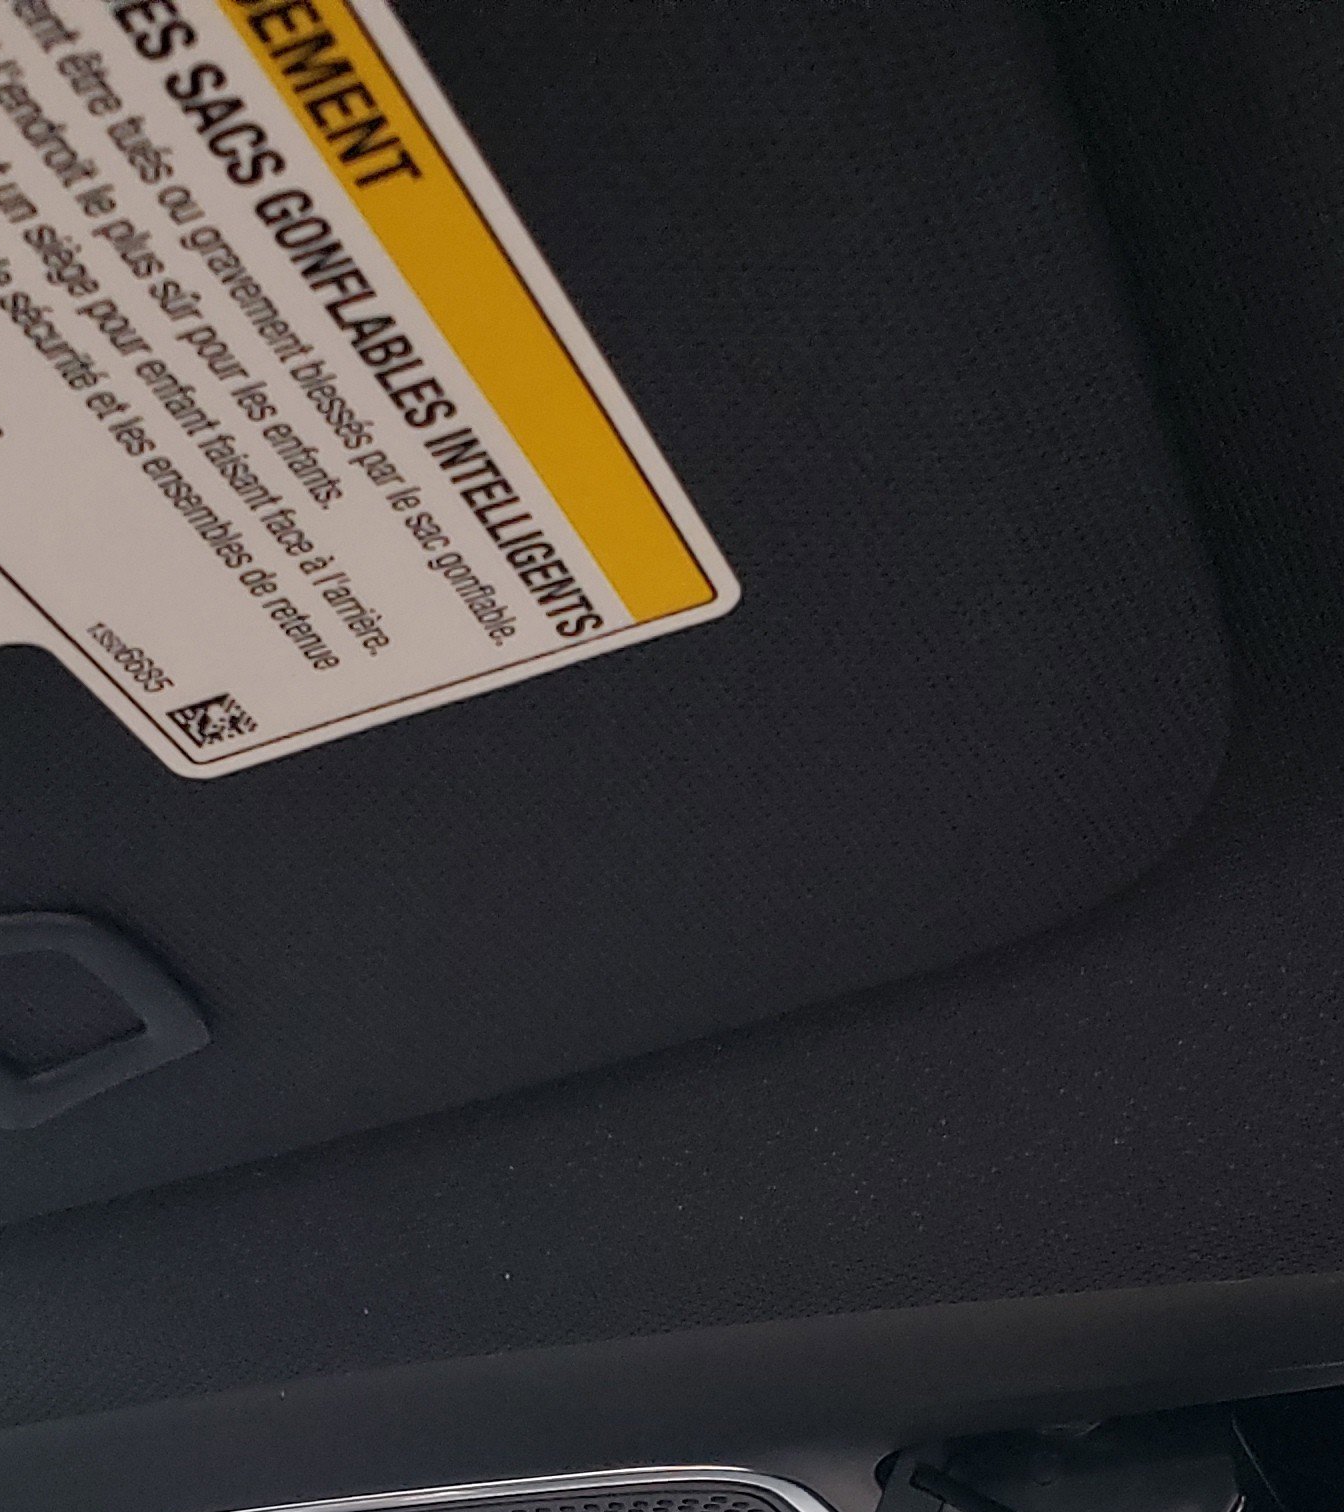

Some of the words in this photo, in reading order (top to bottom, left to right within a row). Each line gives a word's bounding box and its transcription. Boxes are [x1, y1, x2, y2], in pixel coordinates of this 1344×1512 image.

[58, 51, 122, 116] être
[238, 0, 423, 190] EMENT
[107, 115, 174, 184] tués
[75, 184, 116, 217] le
[158, 185, 205, 225] ou
[23, 224, 99, 297] siège
[92, 218, 165, 280] plus
[149, 279, 203, 321] sûr
[180, 226, 314, 363] gravement
[76, 299, 153, 357] pour
[165, 63, 286, 185] SACS
[256, 189, 456, 428] GONFLABLES
[424, 427, 604, 638] INTELLIGENTS
[176, 325, 249, 381] pour
[135, 359, 221, 436] enfant
[231, 380, 277, 422] les
[290, 359, 374, 449] blessés
[0, 291, 109, 390] sécurité
[86, 391, 130, 421] et
[109, 416, 156, 457] les
[143, 456, 253, 569] ensembles
[239, 568, 277, 597] de
[263, 597, 340, 671] retenue
[198, 433, 283, 511] faisant
[263, 423, 343, 510] enfants.
[349, 450, 405, 486] par
[386, 486, 421, 512] le
[259, 508, 314, 556] face
[406, 511, 450, 551] sac
[300, 555, 334, 574] à
[312, 571, 389, 657] l'arrière.
[427, 551, 516, 646] gonflable.
